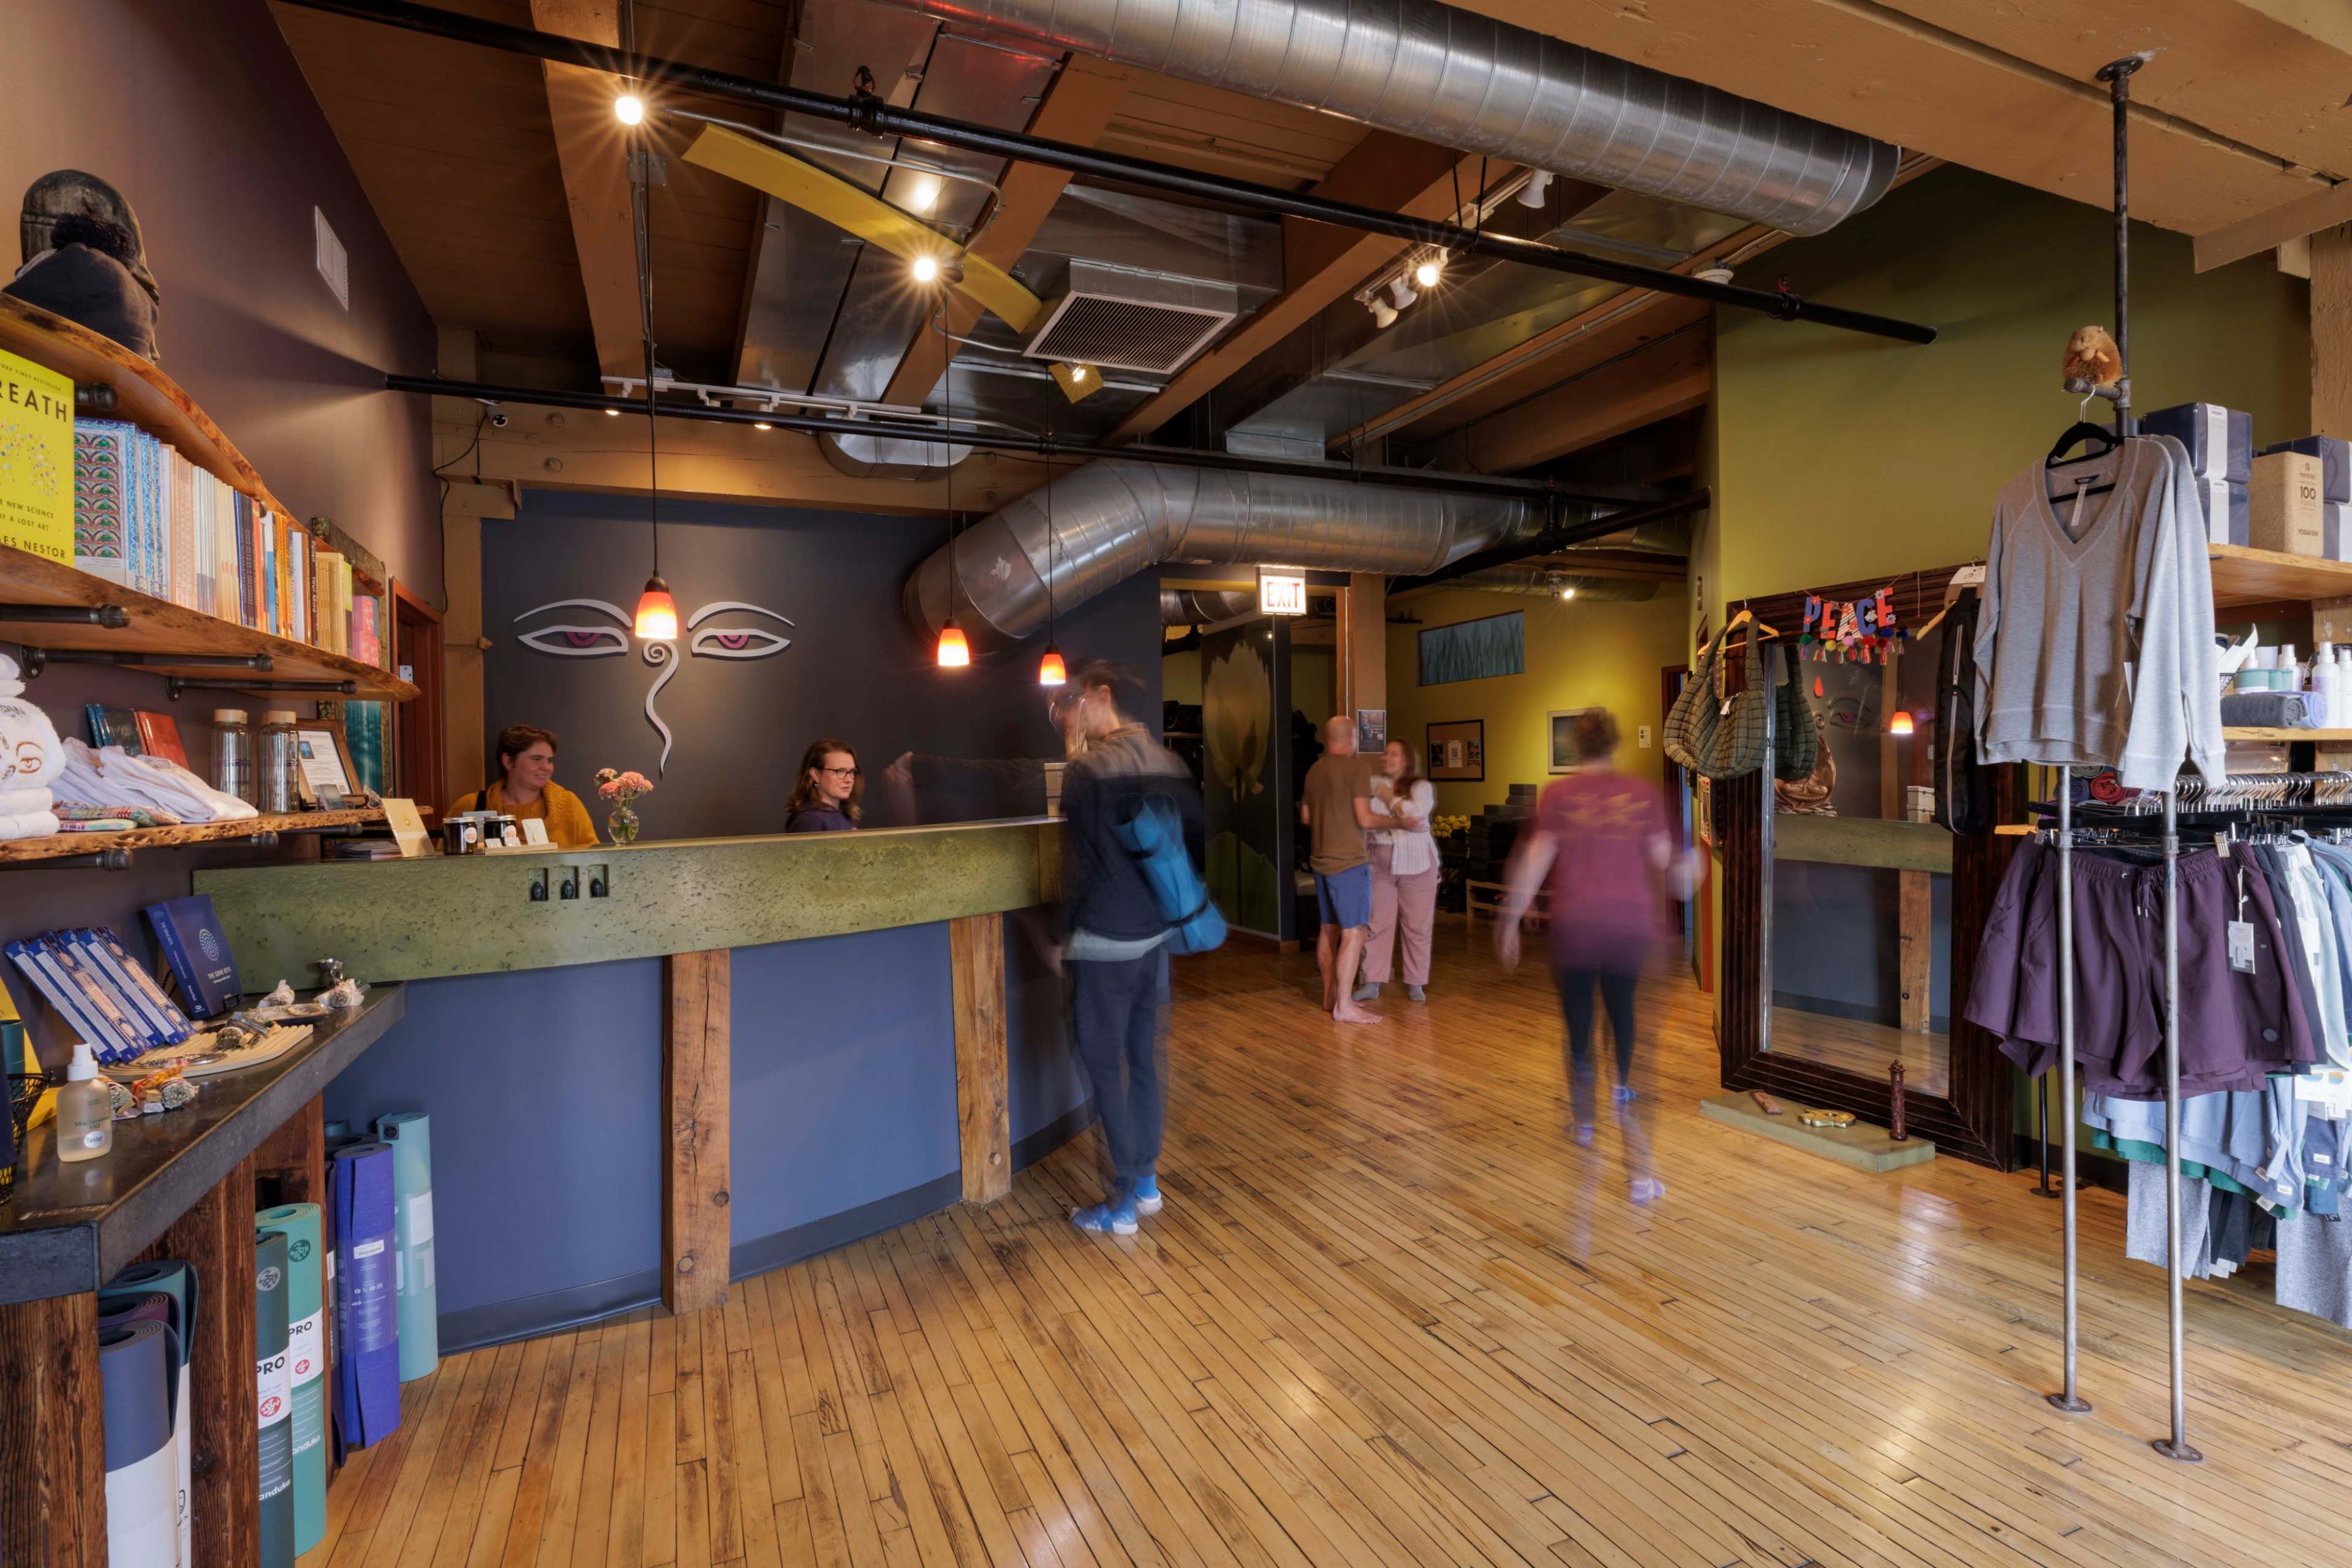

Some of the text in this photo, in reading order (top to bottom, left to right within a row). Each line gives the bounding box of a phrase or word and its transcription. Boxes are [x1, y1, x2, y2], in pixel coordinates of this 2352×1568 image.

[2300, 485, 2316, 500] 100
[7, 500, 23, 510] NEW
[27, 507, 54, 519] SCIENCE
[18, 518, 34, 527] LOST
[24, 540, 66, 559] NESTOR
[1267, 581, 1300, 608] EXIT
[1803, 587, 1896, 640] PEACE
